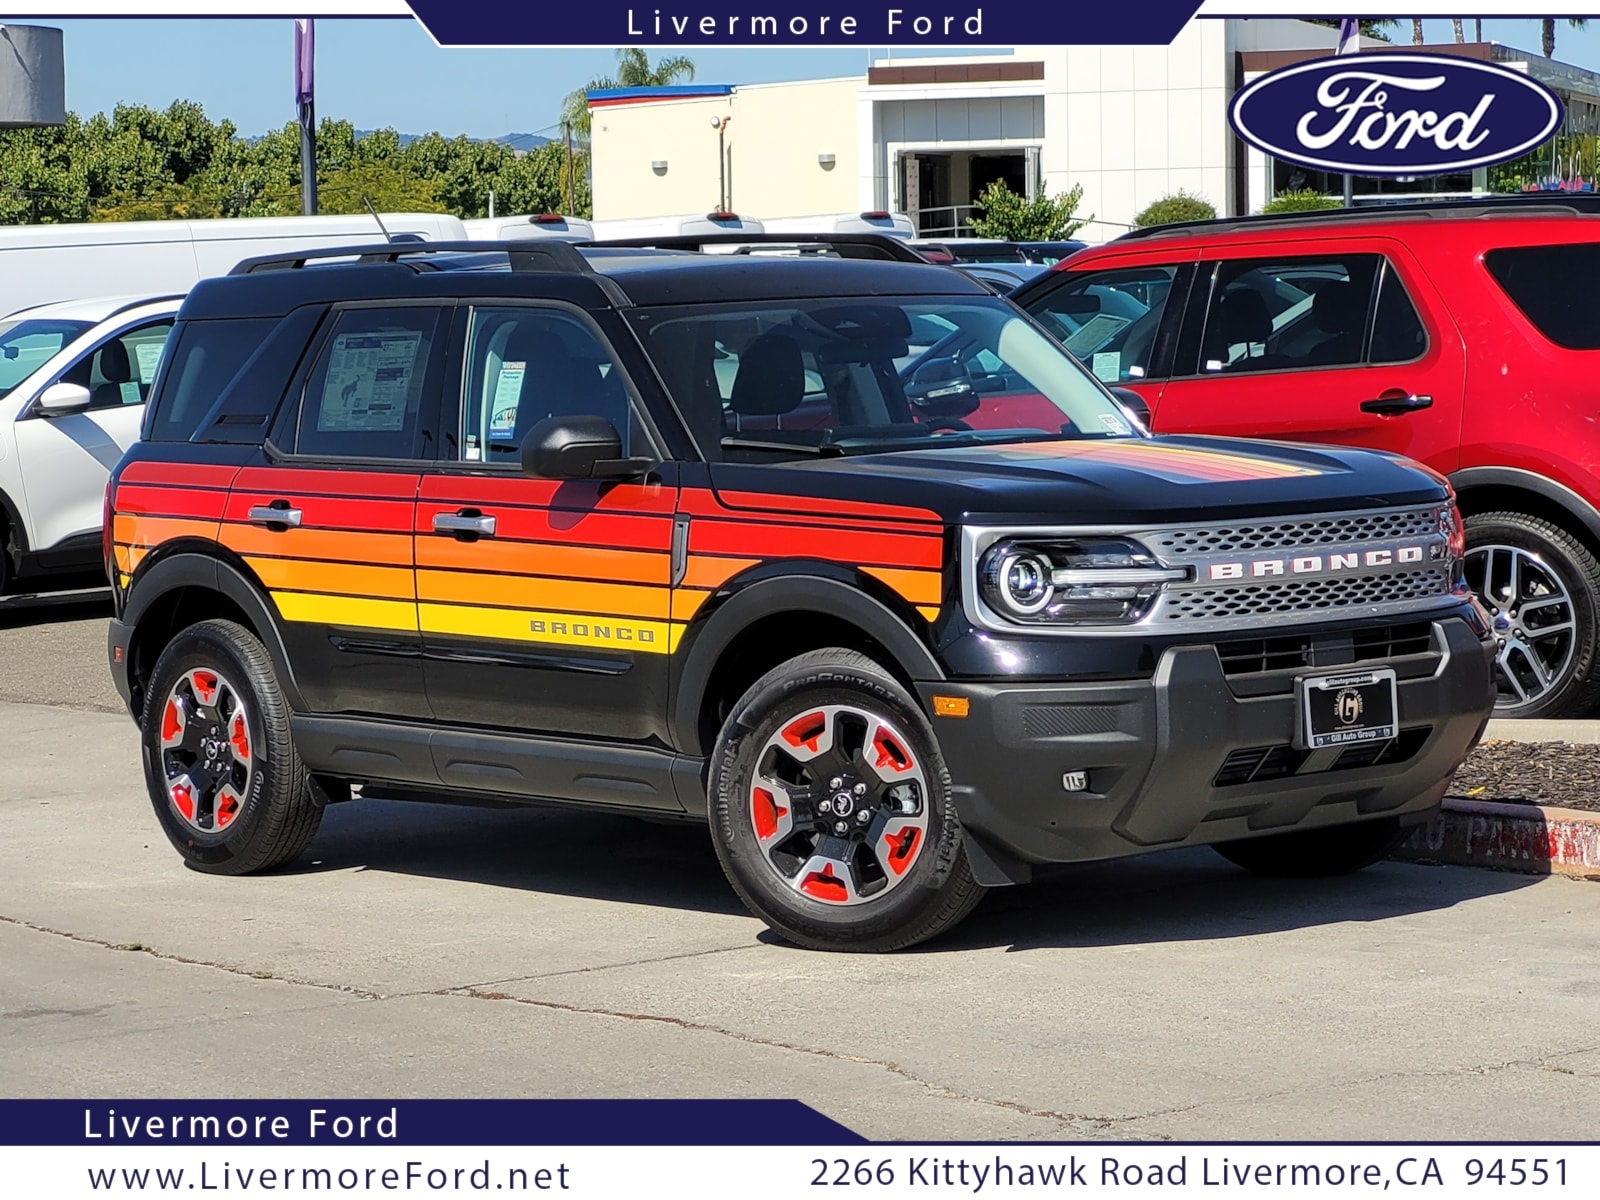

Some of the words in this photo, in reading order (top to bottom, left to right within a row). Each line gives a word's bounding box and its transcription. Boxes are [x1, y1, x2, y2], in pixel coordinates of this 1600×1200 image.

[1209, 546, 1423, 580] BRONCO
[530, 619, 655, 643] BRONCO
[1574, 616, 1593, 681] MICHELIN
[1331, 734, 1342, 742] Gill
[1342, 732, 1357, 741] Auto
[1357, 730, 1377, 739] Group
[716, 745, 739, 843] Continental
